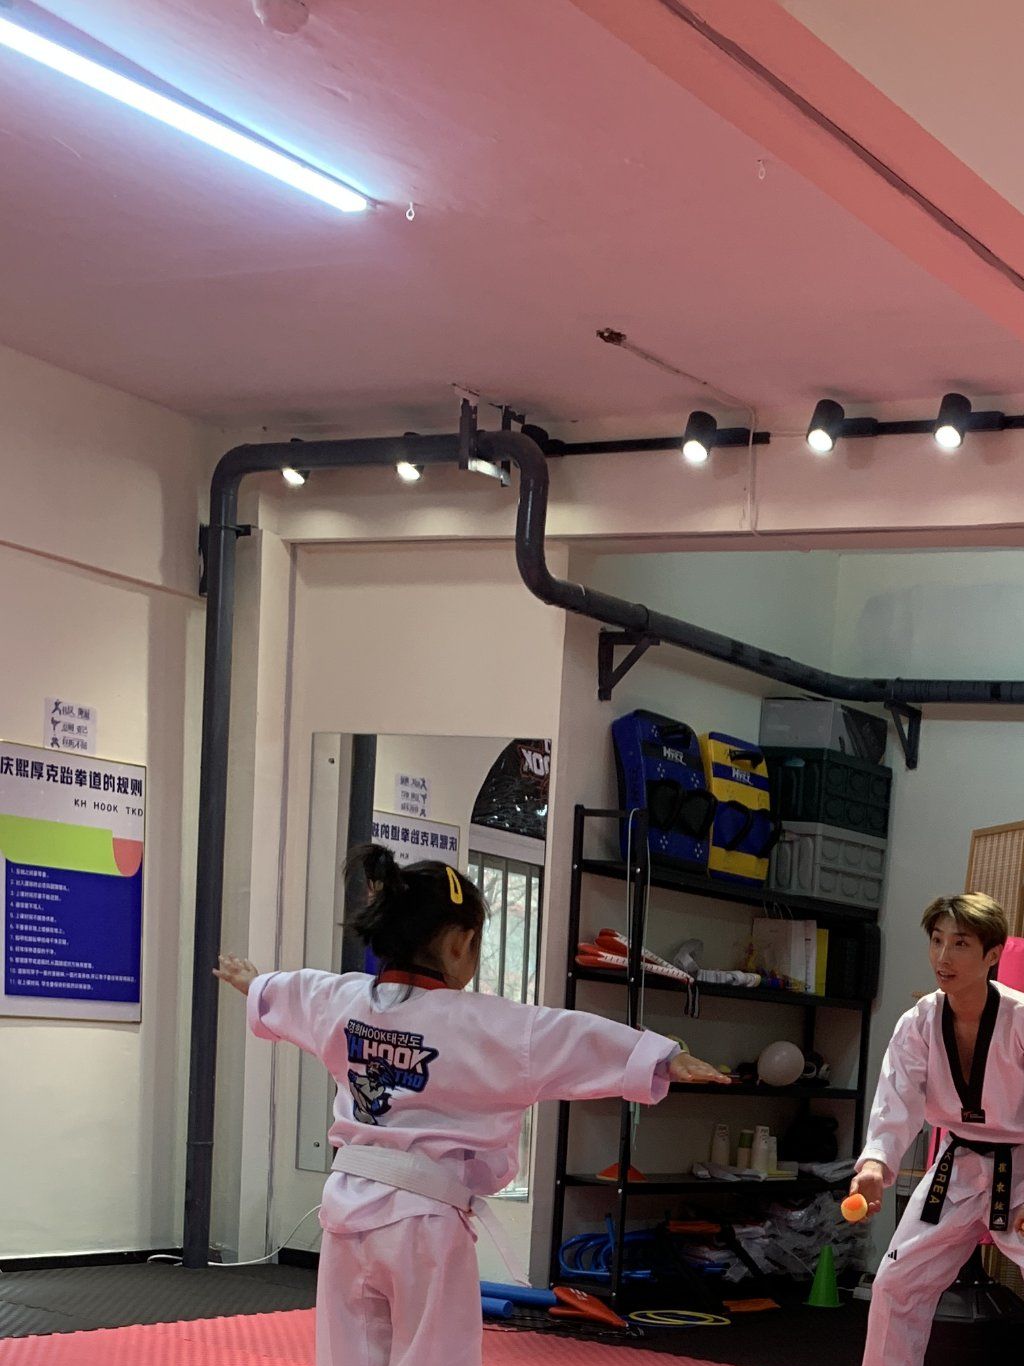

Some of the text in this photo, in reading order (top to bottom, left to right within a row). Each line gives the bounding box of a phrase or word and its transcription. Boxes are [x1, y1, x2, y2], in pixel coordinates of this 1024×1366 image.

[0, 756, 143, 797] 庆熙厚克跆拳道的规则
[74, 798, 143, 817] KH HOOK TKD
[929, 1152, 952, 1204] KOREA
